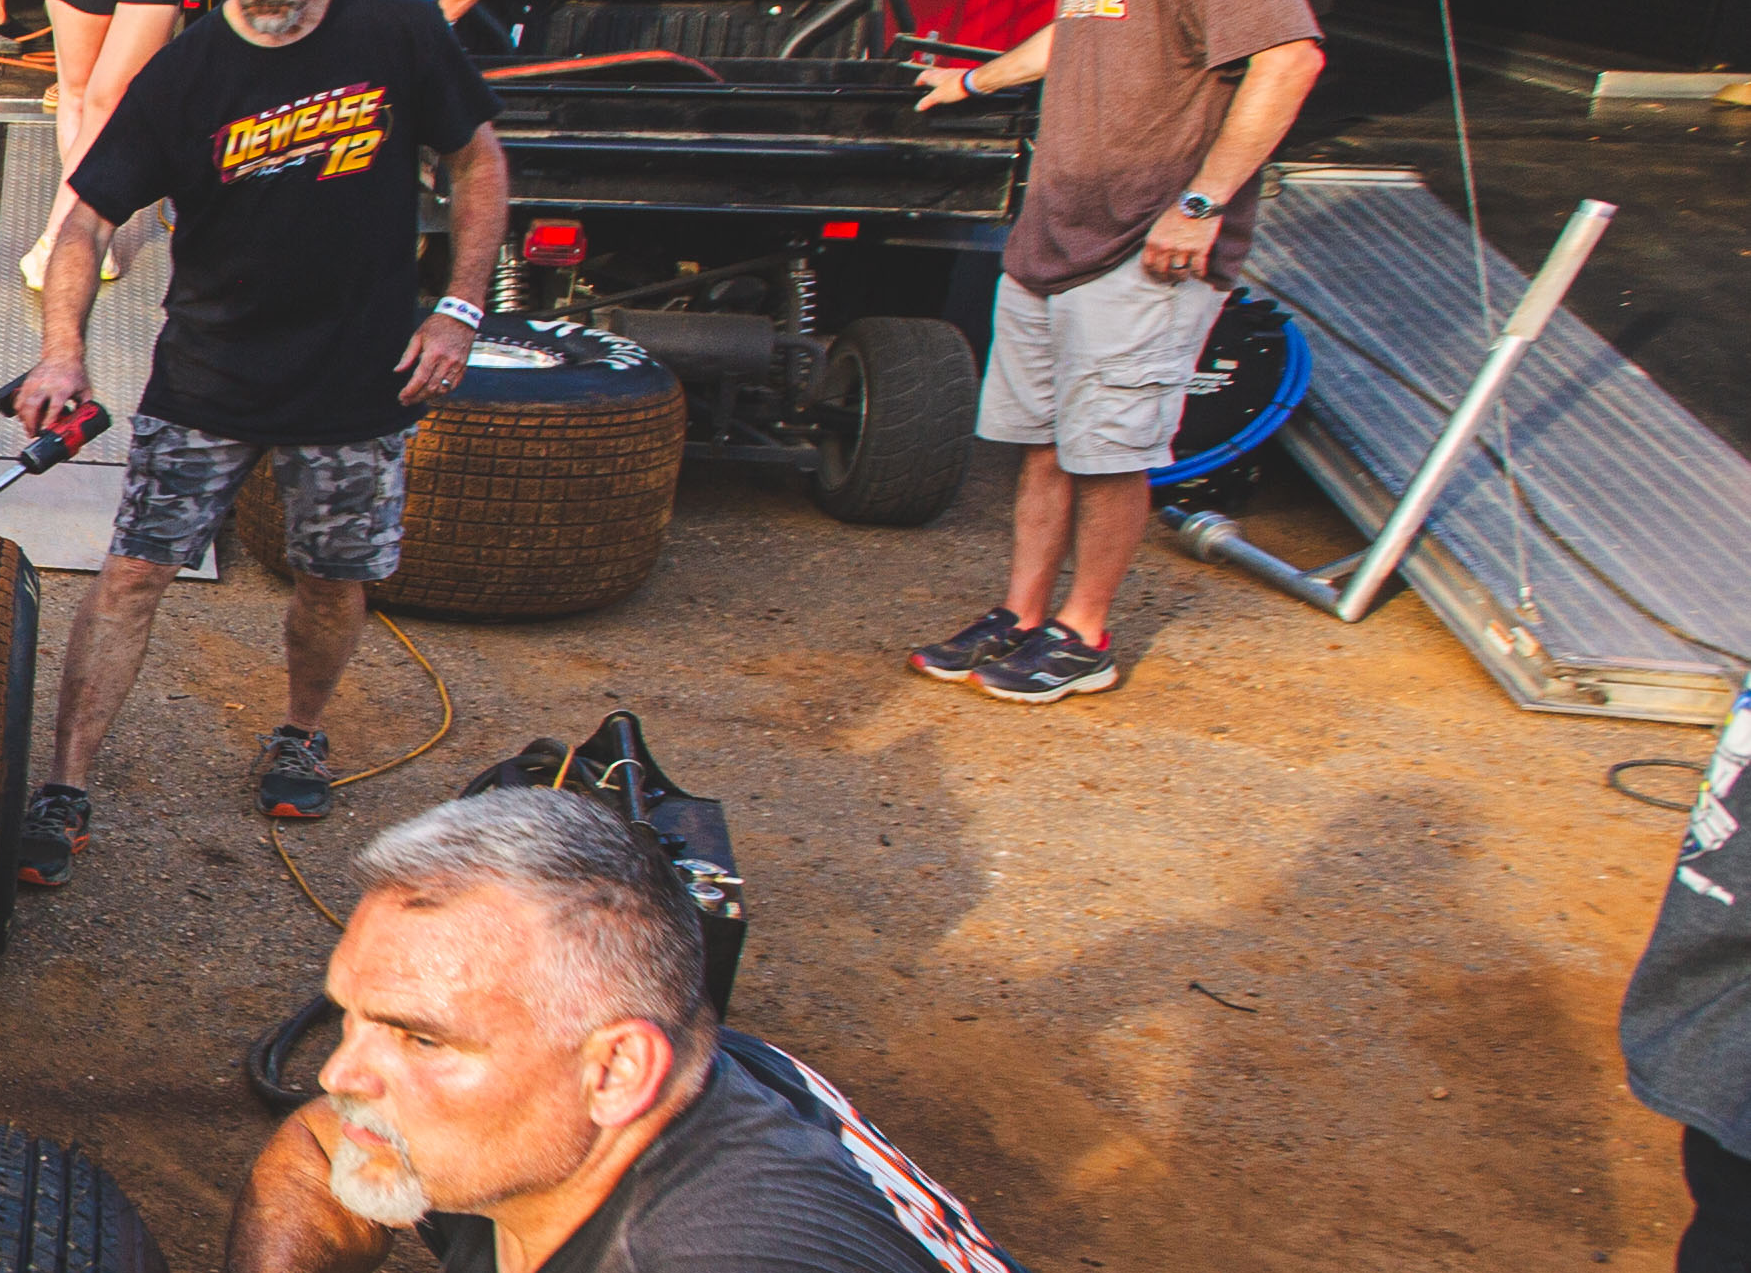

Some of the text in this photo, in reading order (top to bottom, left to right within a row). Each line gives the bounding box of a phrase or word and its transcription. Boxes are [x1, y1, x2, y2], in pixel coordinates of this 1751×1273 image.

[259, 87, 347, 119] LANCE
[222, 89, 386, 168] DEWEASE
[322, 130, 385, 176] 12
